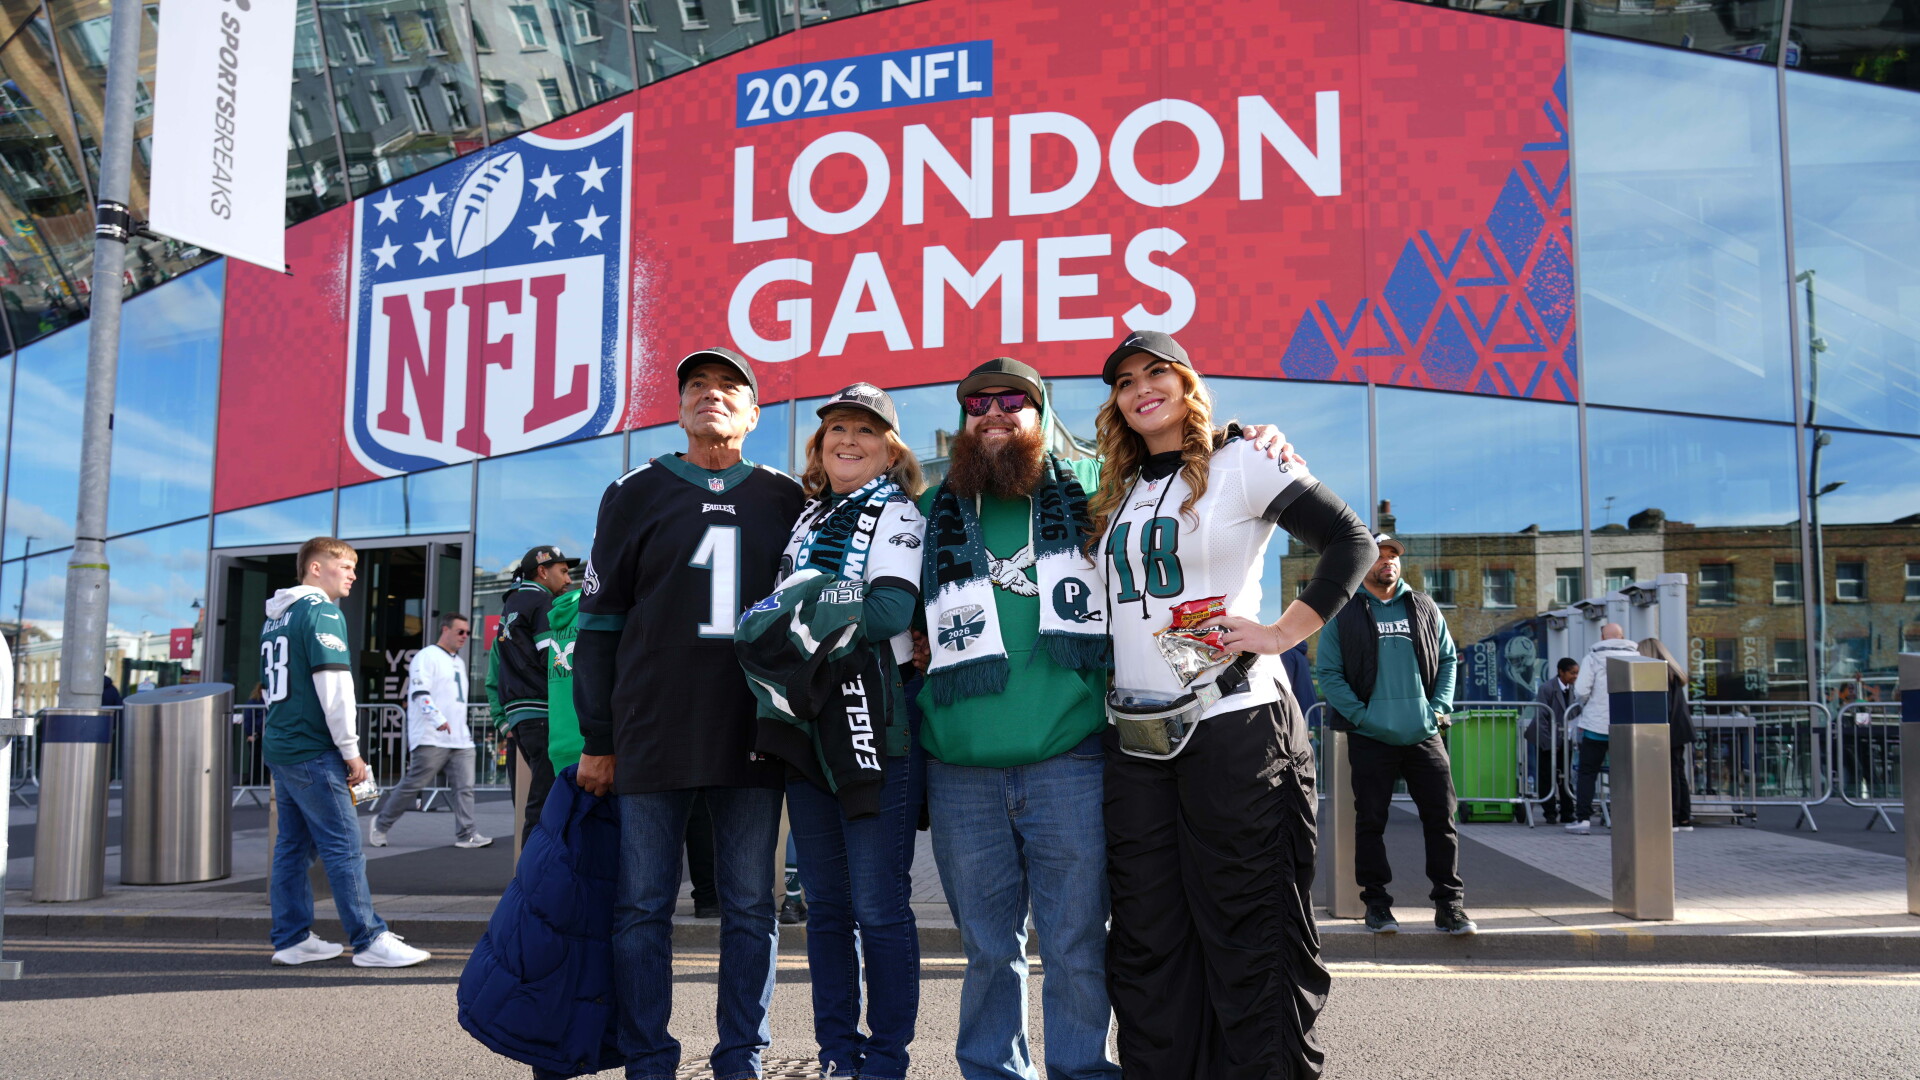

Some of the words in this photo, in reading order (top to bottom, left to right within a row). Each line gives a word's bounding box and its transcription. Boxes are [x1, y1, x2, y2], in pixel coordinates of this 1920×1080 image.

[210, 11, 241, 220] SPORTSBREAKS
[744, 63, 860, 121] 2026
[880, 49, 982, 102] NFL
[732, 89, 1342, 244] LONDON
[727, 226, 1197, 362] GAMES
[377, 273, 589, 458] NFL
[701, 502, 737, 515] EAGLES
[843, 511, 878, 581] BOW
[1105, 516, 1185, 604] 18
[687, 524, 743, 639] 1
[939, 604, 977, 621] LONDON
[1064, 582, 1081, 604] P
[177, 642, 184, 651] 4
[948, 627, 970, 640] 2026
[1473, 642, 1487, 686] COLTS
[1743, 636, 1758, 691] EAGLES
[261, 635, 289, 705] 33
[454, 670, 465, 703] 1
[1690, 637, 1707, 750] COMMANRS
[841, 674, 882, 772] EAGLE
